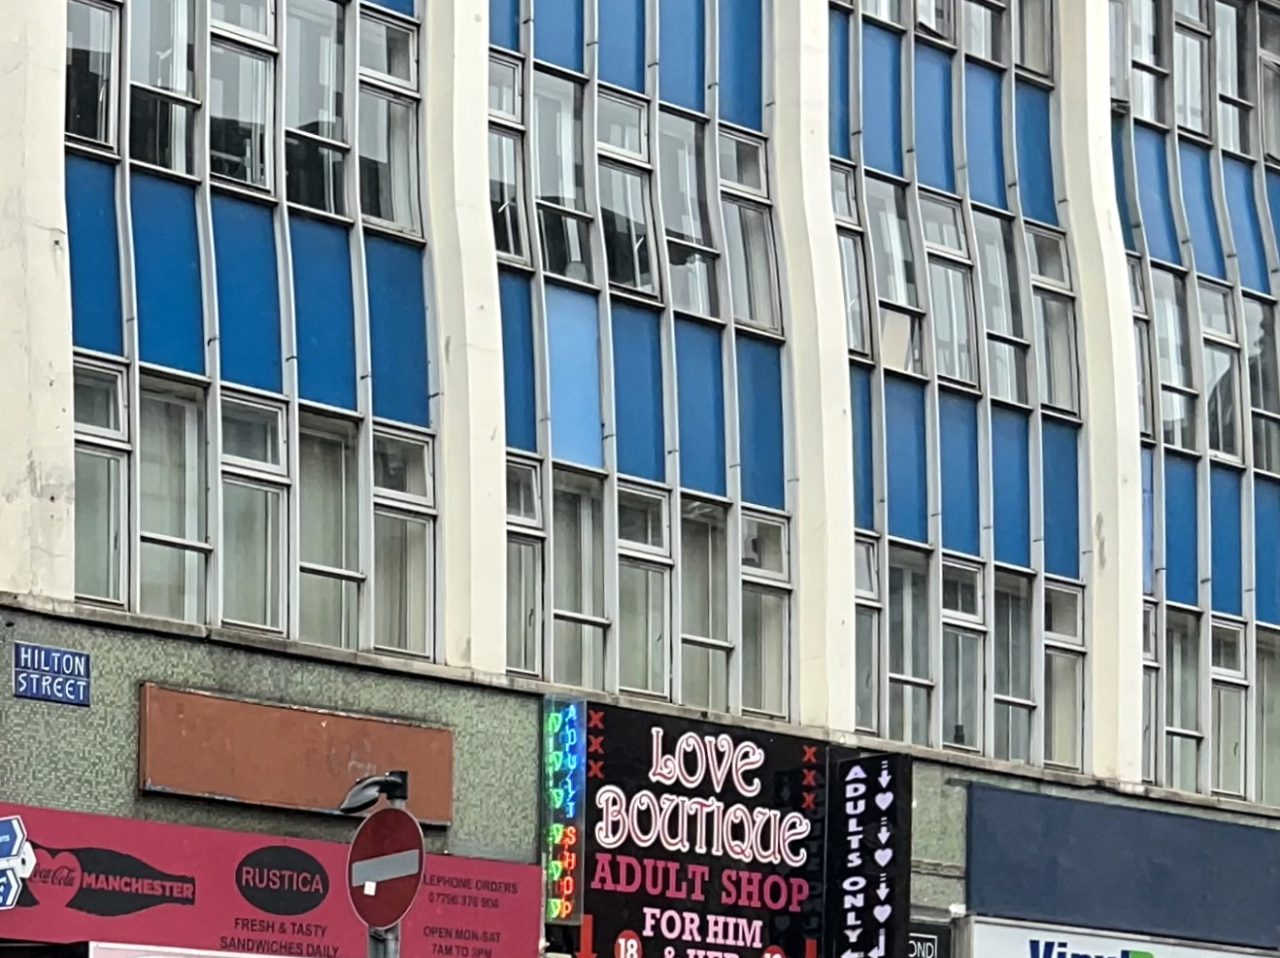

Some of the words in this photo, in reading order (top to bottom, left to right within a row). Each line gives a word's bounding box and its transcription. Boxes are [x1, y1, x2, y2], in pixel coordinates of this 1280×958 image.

[20, 647, 86, 676] HILTON
[18, 672, 87, 701] STREET
[844, 764, 868, 868] ADULTS
[82, 872, 194, 899] MANCHESTER
[242, 866, 324, 894] RUSTICA
[423, 874, 472, 890] LEPHONE
[475, 880, 519, 895] ORDERS
[590, 852, 710, 901] ADULT
[720, 867, 810, 913] SHOP
[841, 874, 867, 945] ONLY
[234, 917, 275, 935] FRESH
[277, 922, 287, 934] &
[290, 922, 328, 939] TASTY
[423, 925, 453, 939] OPEN
[642, 906, 702, 943] FOR
[706, 913, 764, 949] HIM
[220, 935, 304, 956] SANDWICHES
[305, 944, 340, 958] DAILY
[454, 945, 469, 958] TO
